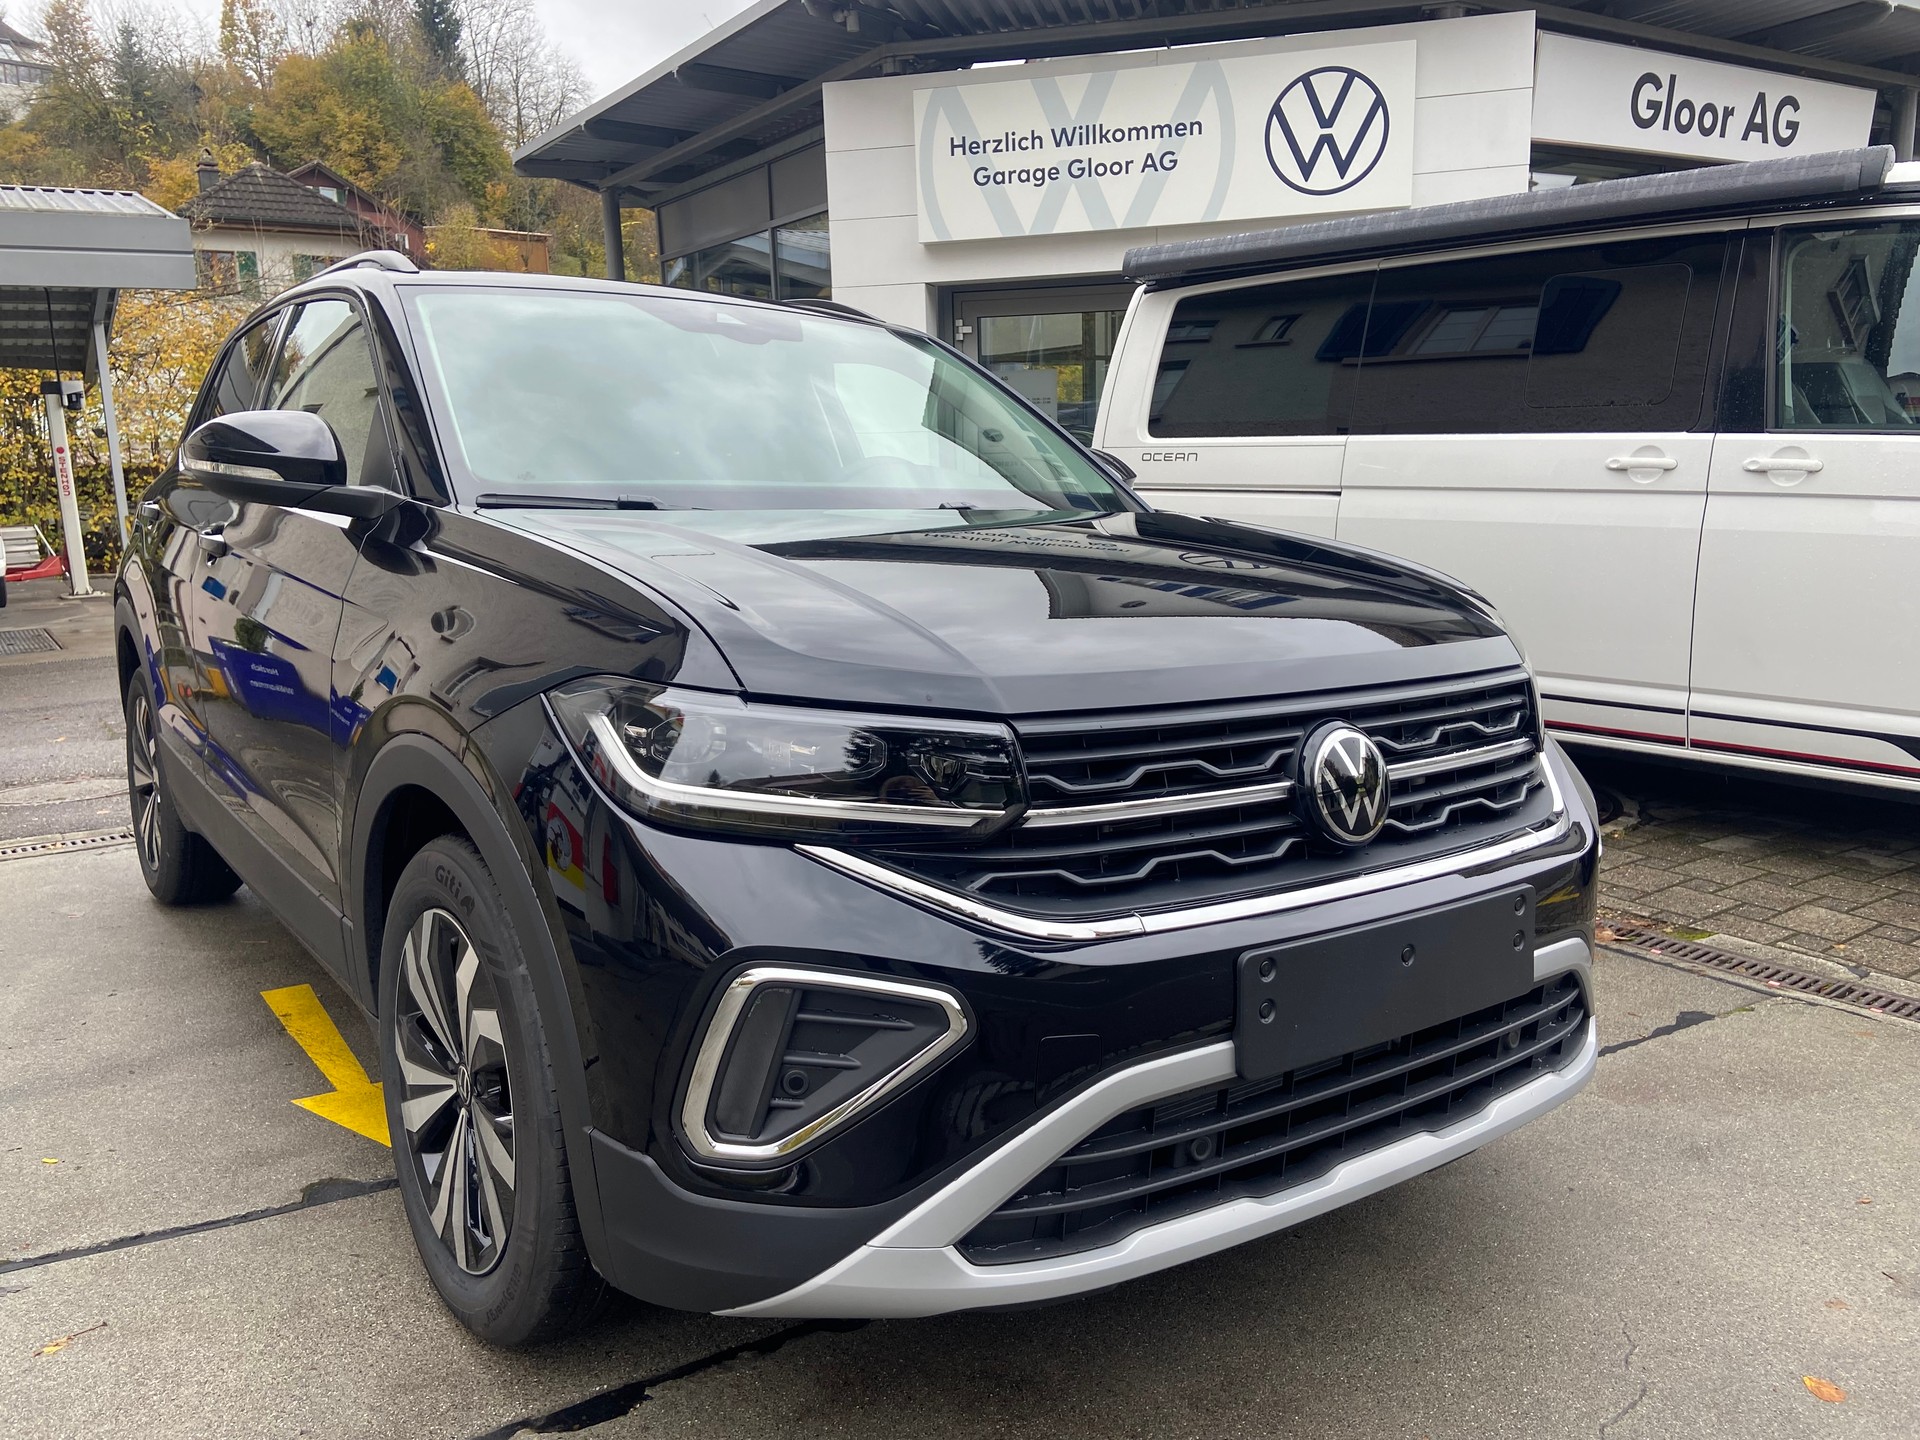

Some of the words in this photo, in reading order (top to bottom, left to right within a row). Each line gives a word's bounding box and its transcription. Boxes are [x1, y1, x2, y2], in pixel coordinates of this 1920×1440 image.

[1630, 72, 1736, 138] Gloor
[1741, 91, 1801, 148] AG
[950, 129, 1044, 156] Herzlich
[1050, 120, 1203, 148] Willkommen
[973, 165, 1060, 187] Garage
[1067, 157, 1134, 179] Gloor
[1140, 150, 1179, 173] AG
[1141, 452, 1199, 462] OCEAN
[435, 864, 462, 900] Giti
